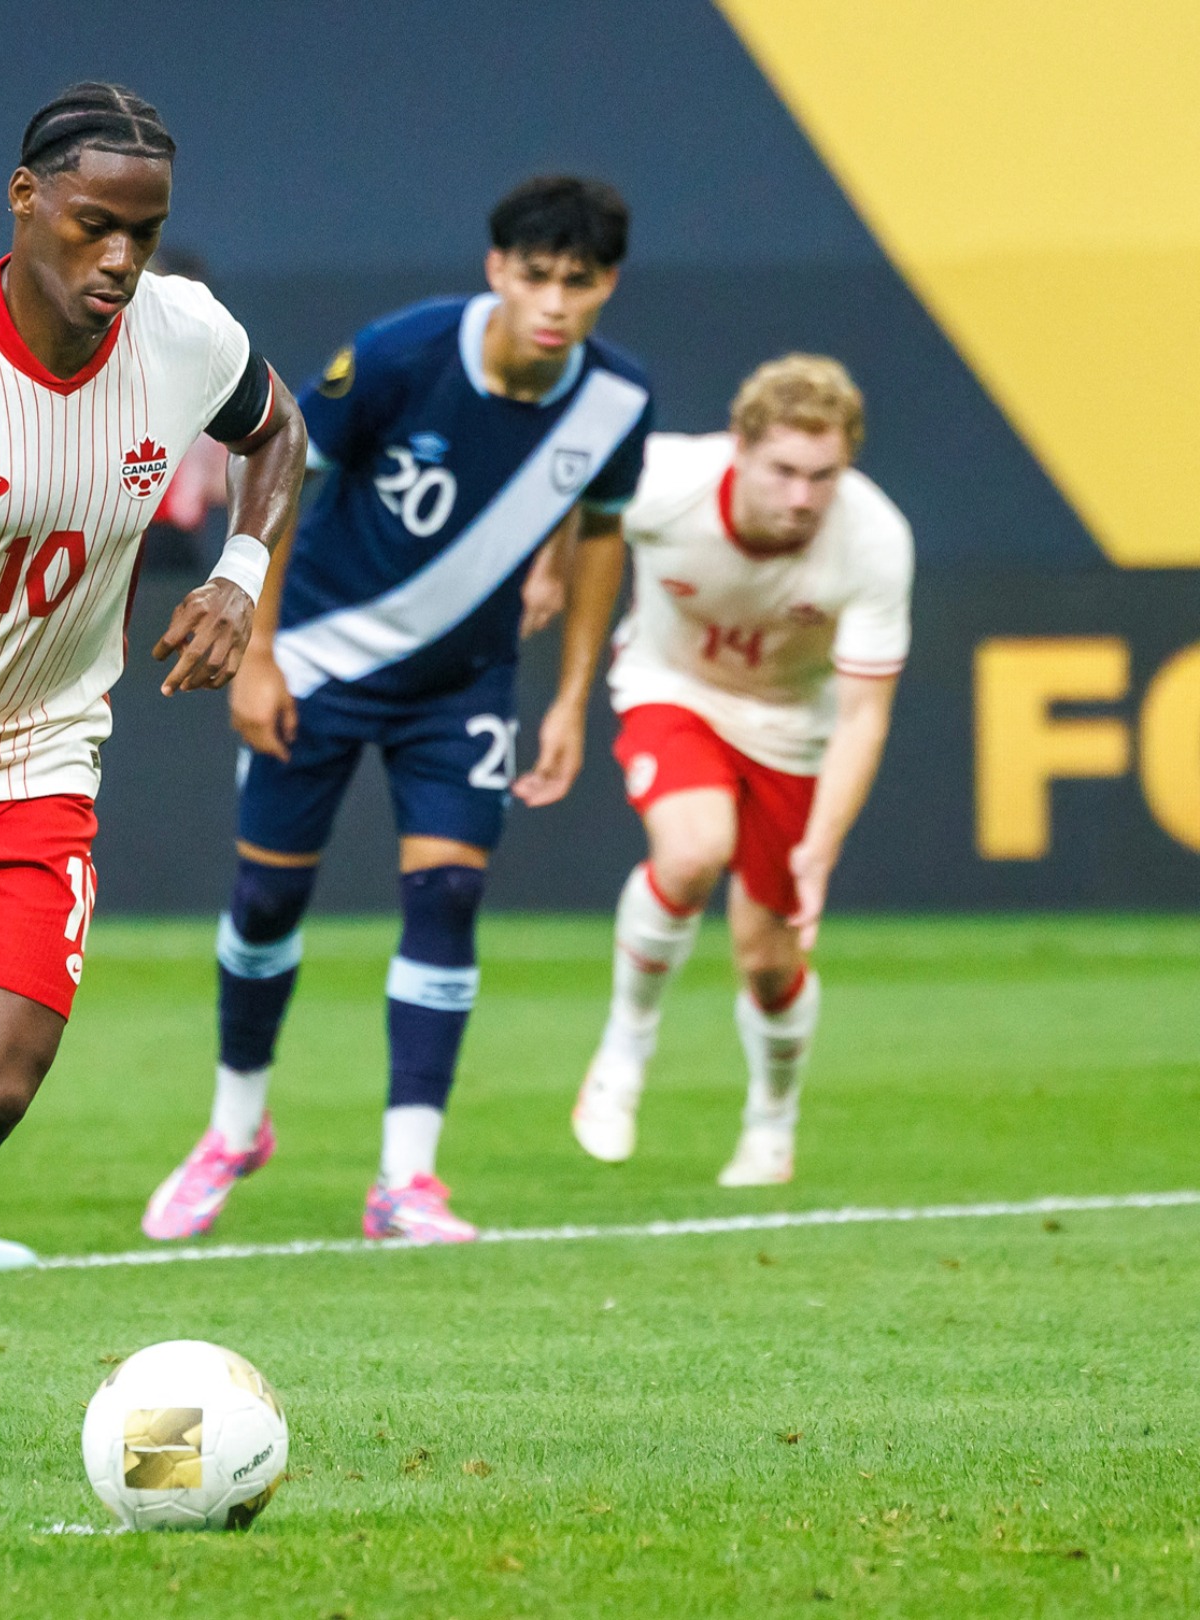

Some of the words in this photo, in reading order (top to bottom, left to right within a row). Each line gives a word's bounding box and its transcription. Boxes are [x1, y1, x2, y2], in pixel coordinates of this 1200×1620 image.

[122, 460, 167, 475] CANADA
[373, 446, 458, 538] 20
[703, 622, 766, 670] 14
[233, 1444, 273, 1482] molten
